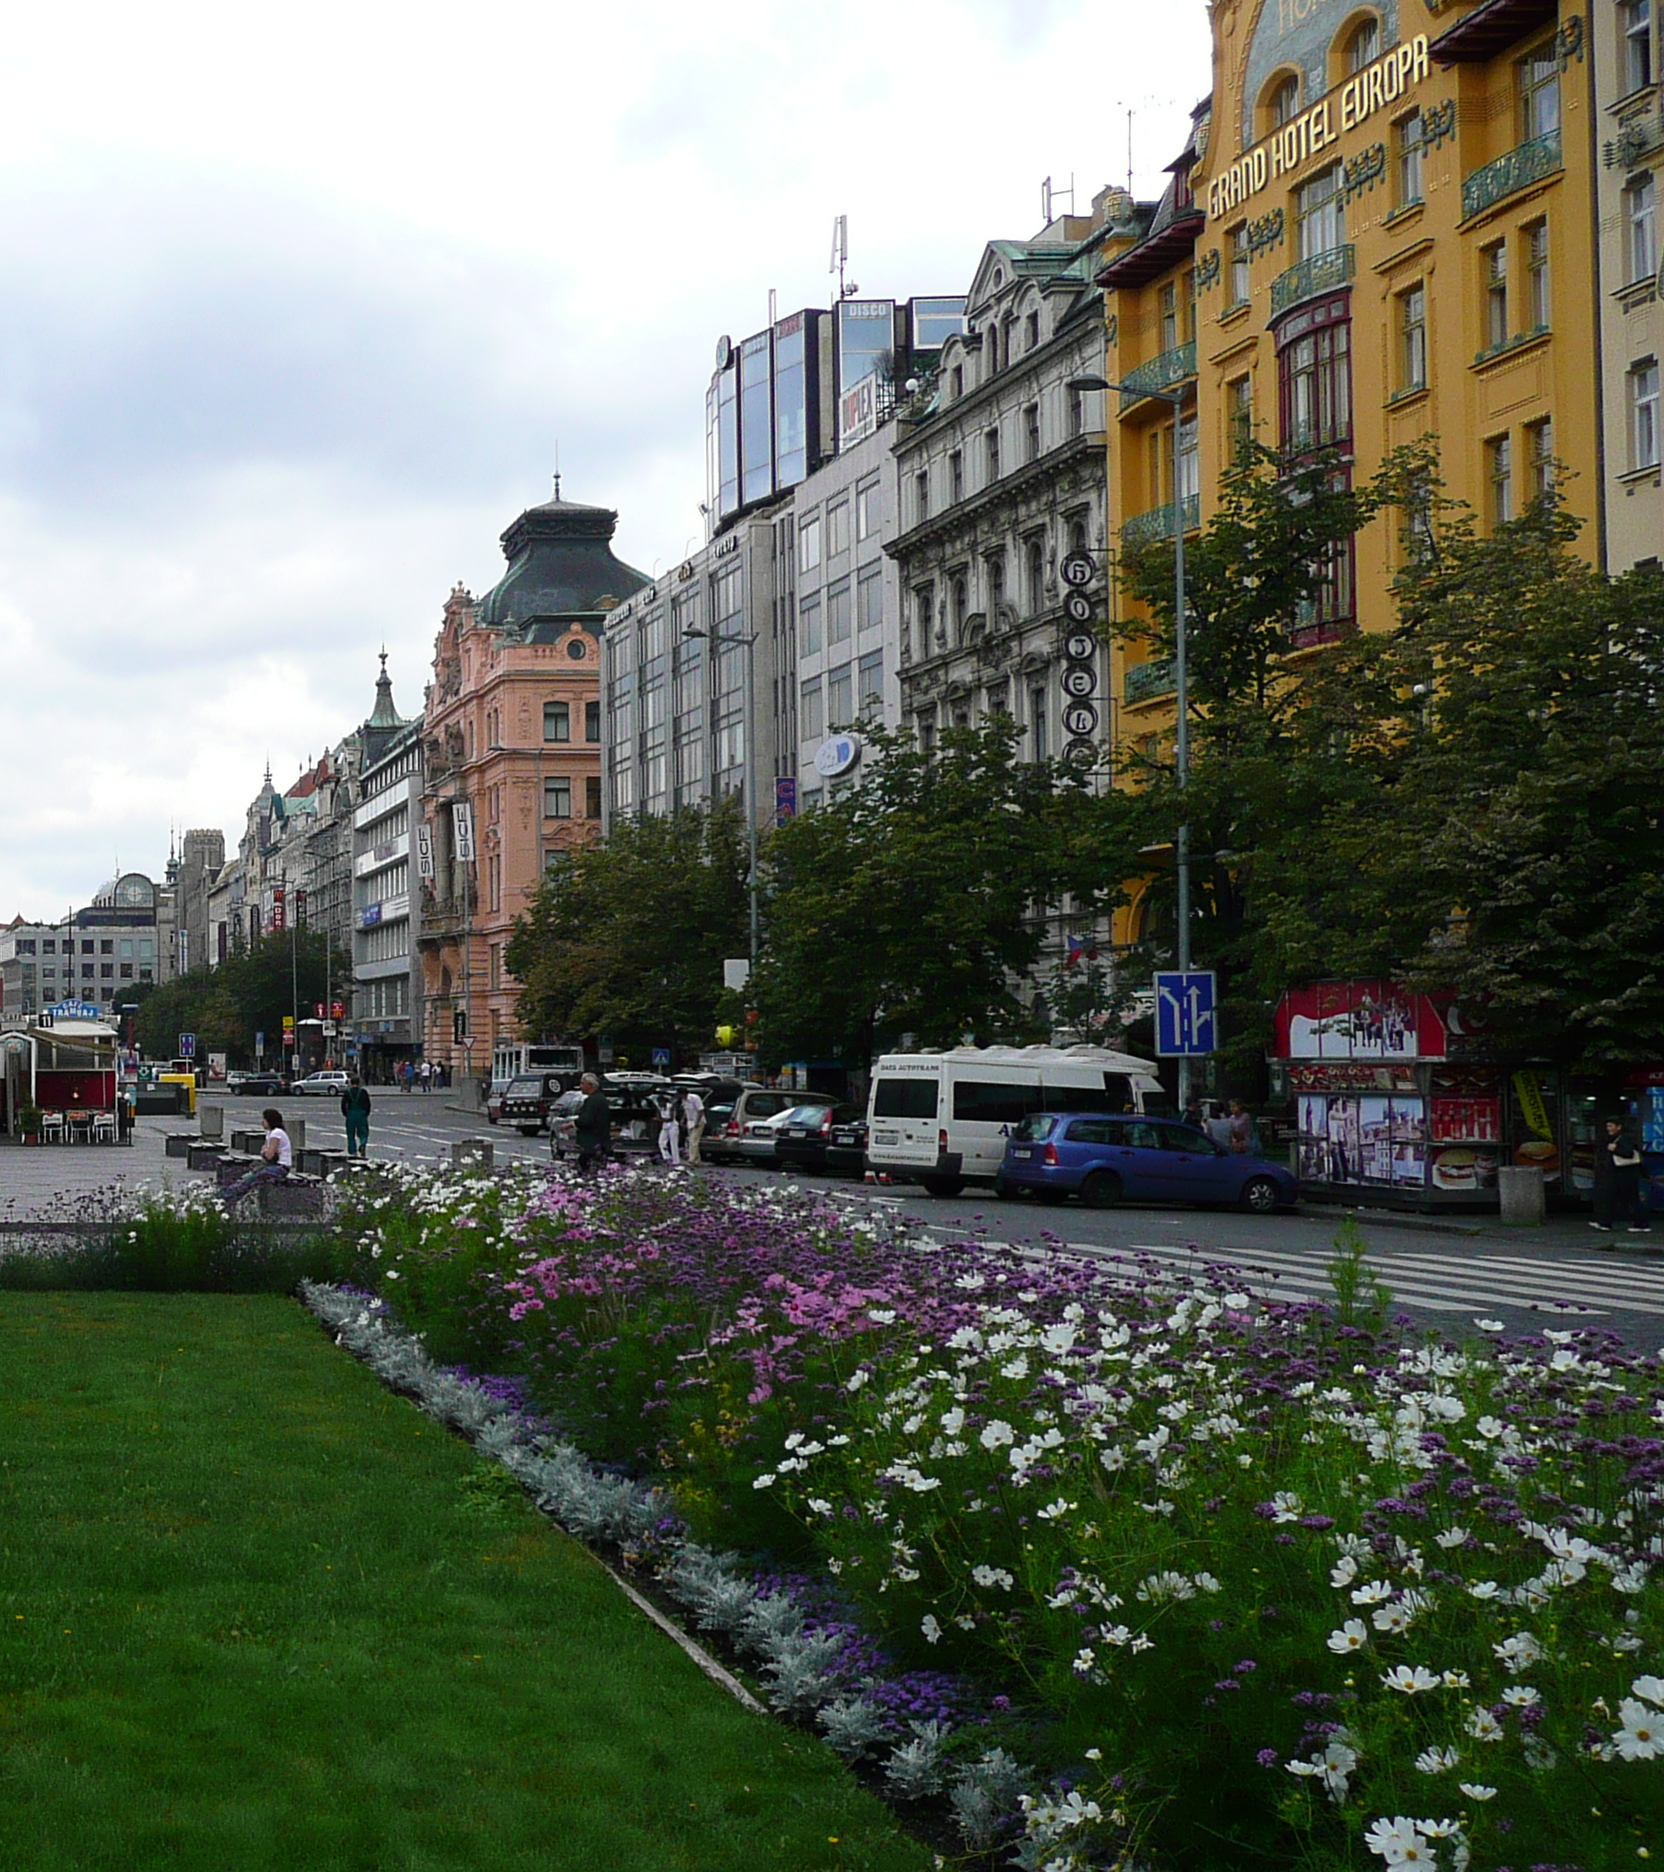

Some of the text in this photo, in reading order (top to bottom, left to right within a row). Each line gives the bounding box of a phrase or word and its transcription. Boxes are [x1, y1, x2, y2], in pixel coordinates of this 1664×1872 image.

[1208, 33, 1430, 220] GRAND HOTEL EUROPA
[849, 304, 886, 317] DISCO
